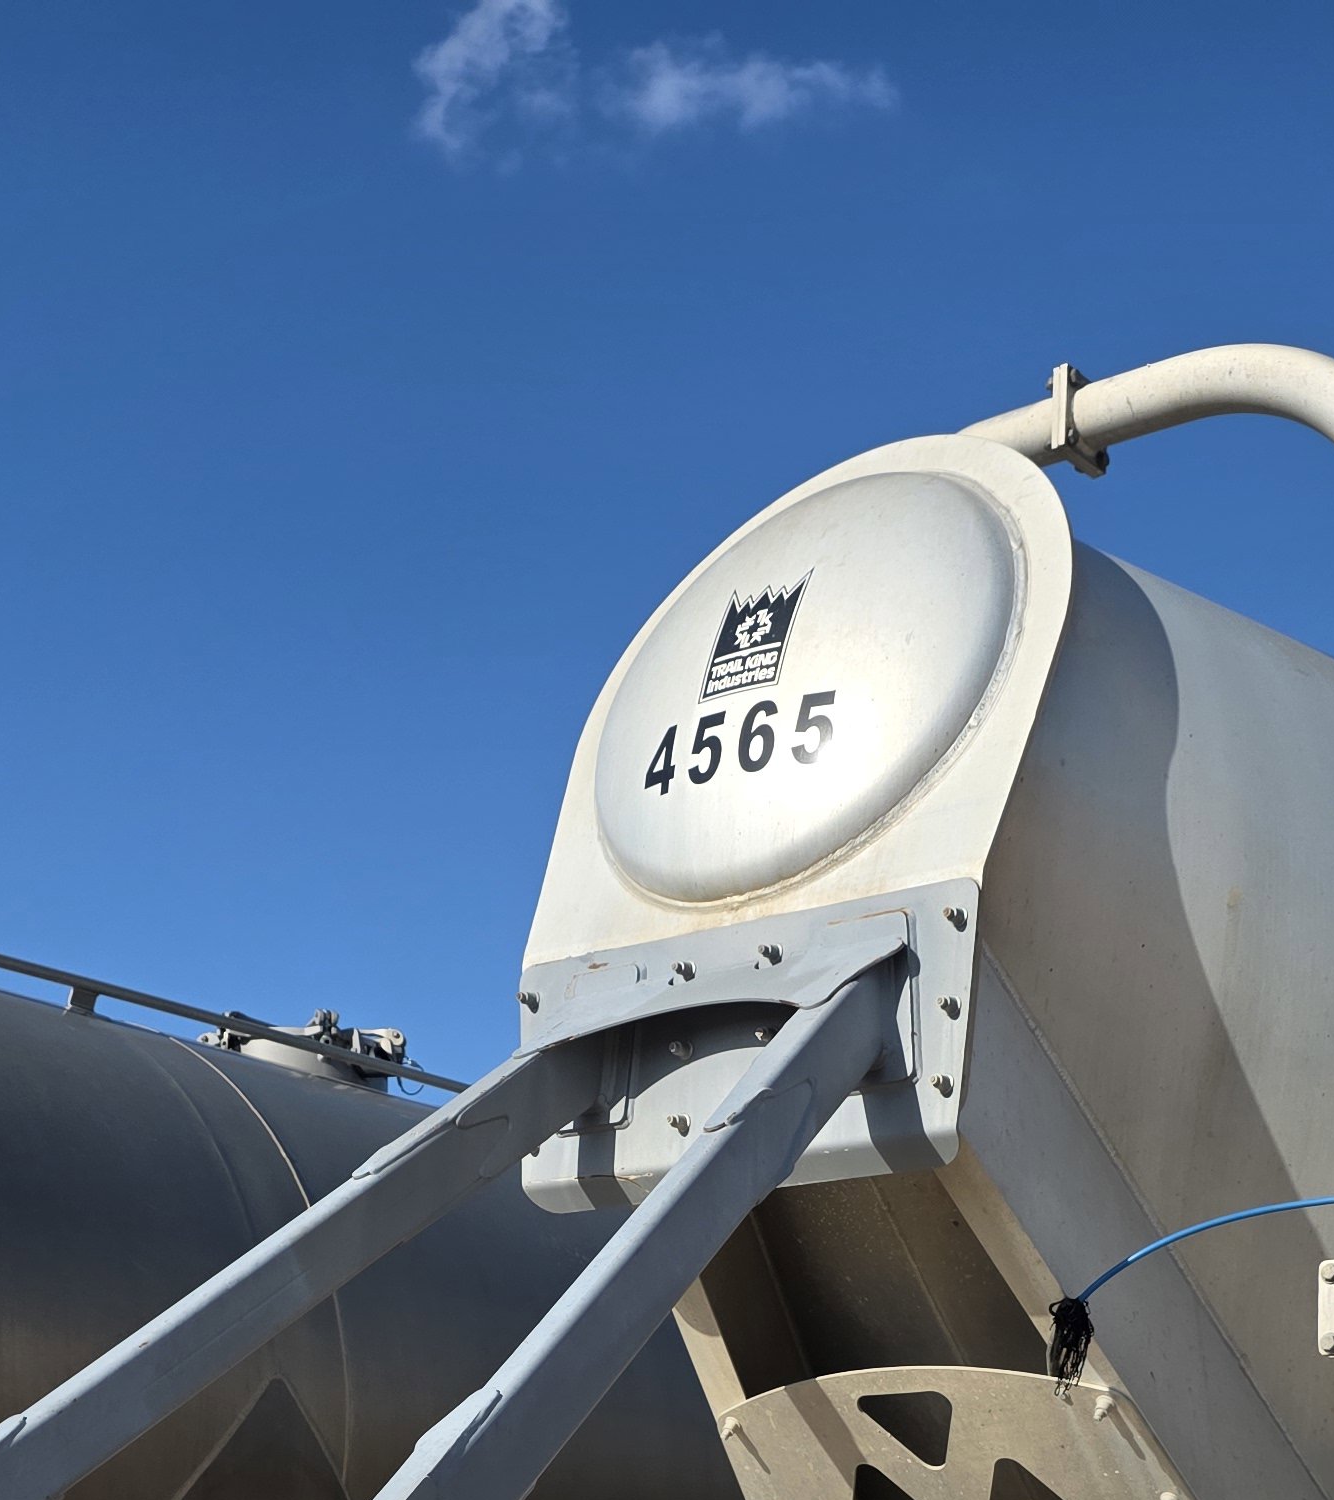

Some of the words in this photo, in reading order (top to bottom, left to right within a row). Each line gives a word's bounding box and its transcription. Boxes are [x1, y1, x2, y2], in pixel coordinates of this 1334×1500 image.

[705, 666, 776, 694] Industries
[711, 658, 744, 679] TRAIL
[644, 690, 836, 796] 4565
